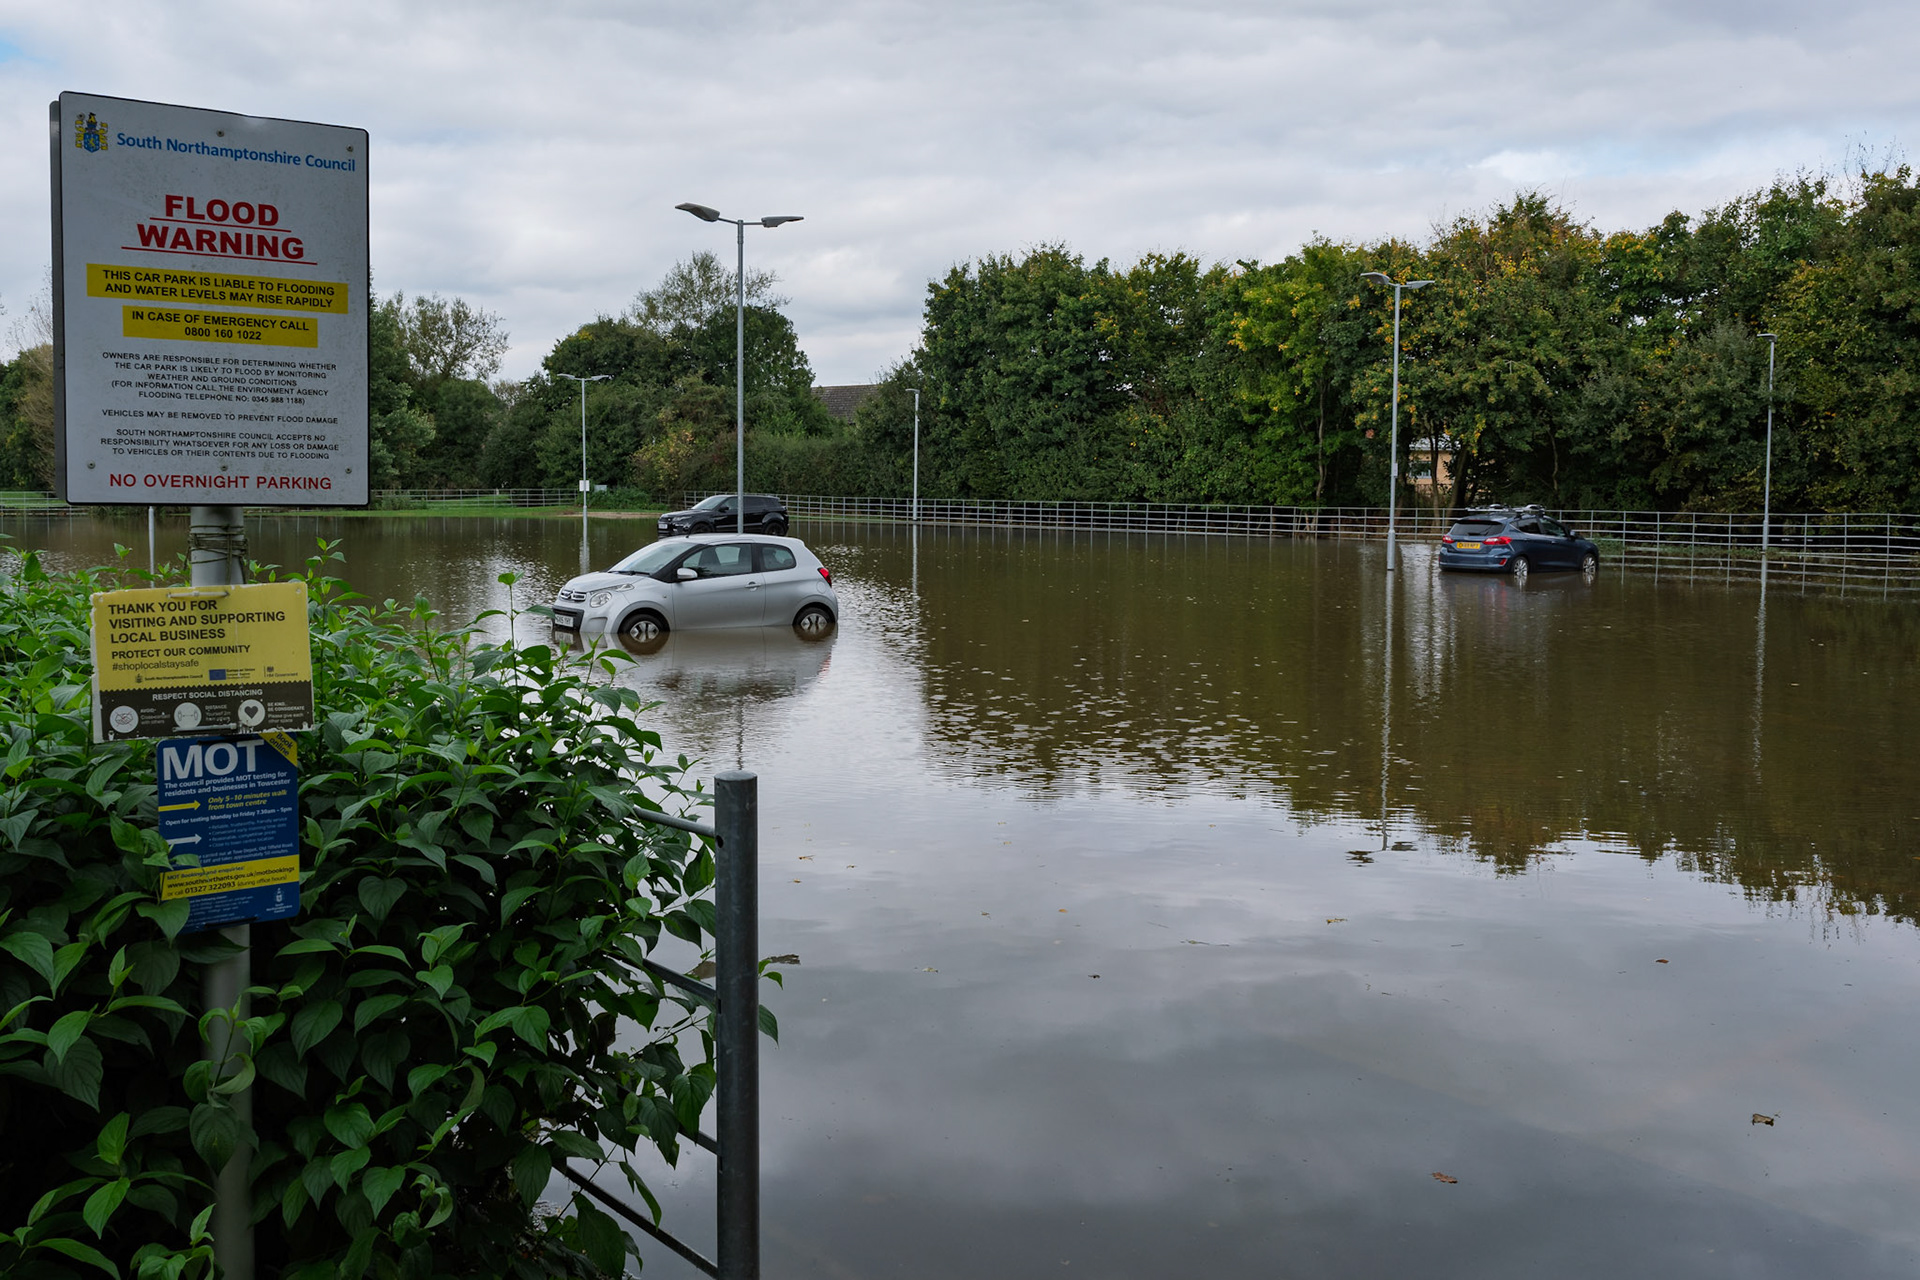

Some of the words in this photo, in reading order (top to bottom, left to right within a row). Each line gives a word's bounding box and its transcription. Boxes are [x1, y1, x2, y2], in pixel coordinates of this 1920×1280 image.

[117, 132, 162, 150] South
[166, 139, 301, 166] Northamptonshire
[305, 155, 355, 172] Council
[165, 194, 278, 226] FLOOD
[137, 224, 304, 260] WARNING
[103, 270, 130, 280] THIS
[134, 272, 160, 282] CAR
[164, 274, 196, 285] PARK
[200, 277, 210, 286] IS
[214, 278, 255, 290] LIABLE
[259, 282, 274, 291] TO
[277, 283, 334, 296] FLOODING
[105, 283, 131, 293] AND
[135, 285, 177, 297] WATER
[181, 288, 226, 300] LEVELS
[230, 292, 253, 302] MAY
[257, 294, 282, 304] RISE
[286, 296, 332, 308] RAPIDLY
[132, 311, 143, 320] IN
[148, 312, 180, 322] CASE
[184, 314, 200, 323] OF
[204, 316, 276, 328] EMERGENCY
[280, 320, 310, 330] CALL
[185, 327, 210, 337] 0800
[214, 329, 233, 338] 160
[237, 330, 261, 340] 1022
[102, 352, 140, 360] OWNERS
[143, 354, 160, 362] ARE
[163, 355, 220, 364] RESPONSIBLE
[242, 360, 296, 368] DETERMINING
[299, 362, 337, 370] WHETHER
[114, 362, 131, 370] THE
[154, 364, 177, 372] PARK
[235, 368, 261, 376] FLOOD
[277, 371, 327, 379] MONITORING
[148, 373, 188, 381] WEATHER
[191, 375, 208, 383] AND
[211, 376, 246, 384] GROUND
[248, 378, 297, 387] CONDITIONS
[135, 381, 193, 390] INFORMATION
[196, 384, 216, 392] CALL
[238, 386, 294, 394] ENVIRONMENT
[297, 388, 328, 396] AGENCY
[139, 391, 182, 399] FLOODING
[185, 393, 232, 402] TELEPHONE
[102, 409, 144, 417] VEHICLES
[181, 412, 221, 420] REMOVED
[238, 414, 274, 422] PREVENT
[100, 438, 170, 447] RESPONSIBILITY
[173, 440, 229, 448] WHATSOEVER
[148, 430, 236, 439] NORTHAMPTONSHIRE
[239, 432, 273, 440] COUNCIL
[276, 433, 312, 441] ACCEPTS
[127, 448, 168, 456] VEHICLES
[213, 450, 256, 458] CONTENTS
[290, 452, 329, 460] FLOODING
[109, 473, 136, 488] NO
[144, 474, 250, 489] OVERNIGHT
[256, 476, 332, 490] PARKING
[108, 602, 155, 615] THANK
[158, 601, 186, 612] YOU
[190, 600, 217, 611] FOR
[109, 617, 166, 629] VISITING
[169, 615, 197, 626] AND
[200, 611, 285, 625] SUPPORTING
[111, 630, 156, 644] LOCAL
[160, 628, 225, 641] BUSINESS
[112, 649, 160, 659] PROTECT
[166, 648, 186, 657] OUR
[190, 645, 250, 656] COMMUNITY
[112, 659, 199, 671] #shoplocalstaysafe
[152, 692, 187, 700] RESPECT
[218, 689, 263, 697] DISTANCING
[270, 738, 289, 756] online
[277, 732, 293, 749] Book
[163, 740, 264, 780] MOT
[165, 788, 196, 796] residents
[212, 784, 248, 792] businesses
[257, 779, 291, 787] Towcester
[179, 779, 204, 787] council
[206, 776, 234, 786] provides
[253, 772, 276, 780] testing
[185, 886, 207, 894] 01327
[209, 881, 236, 890] 322093
